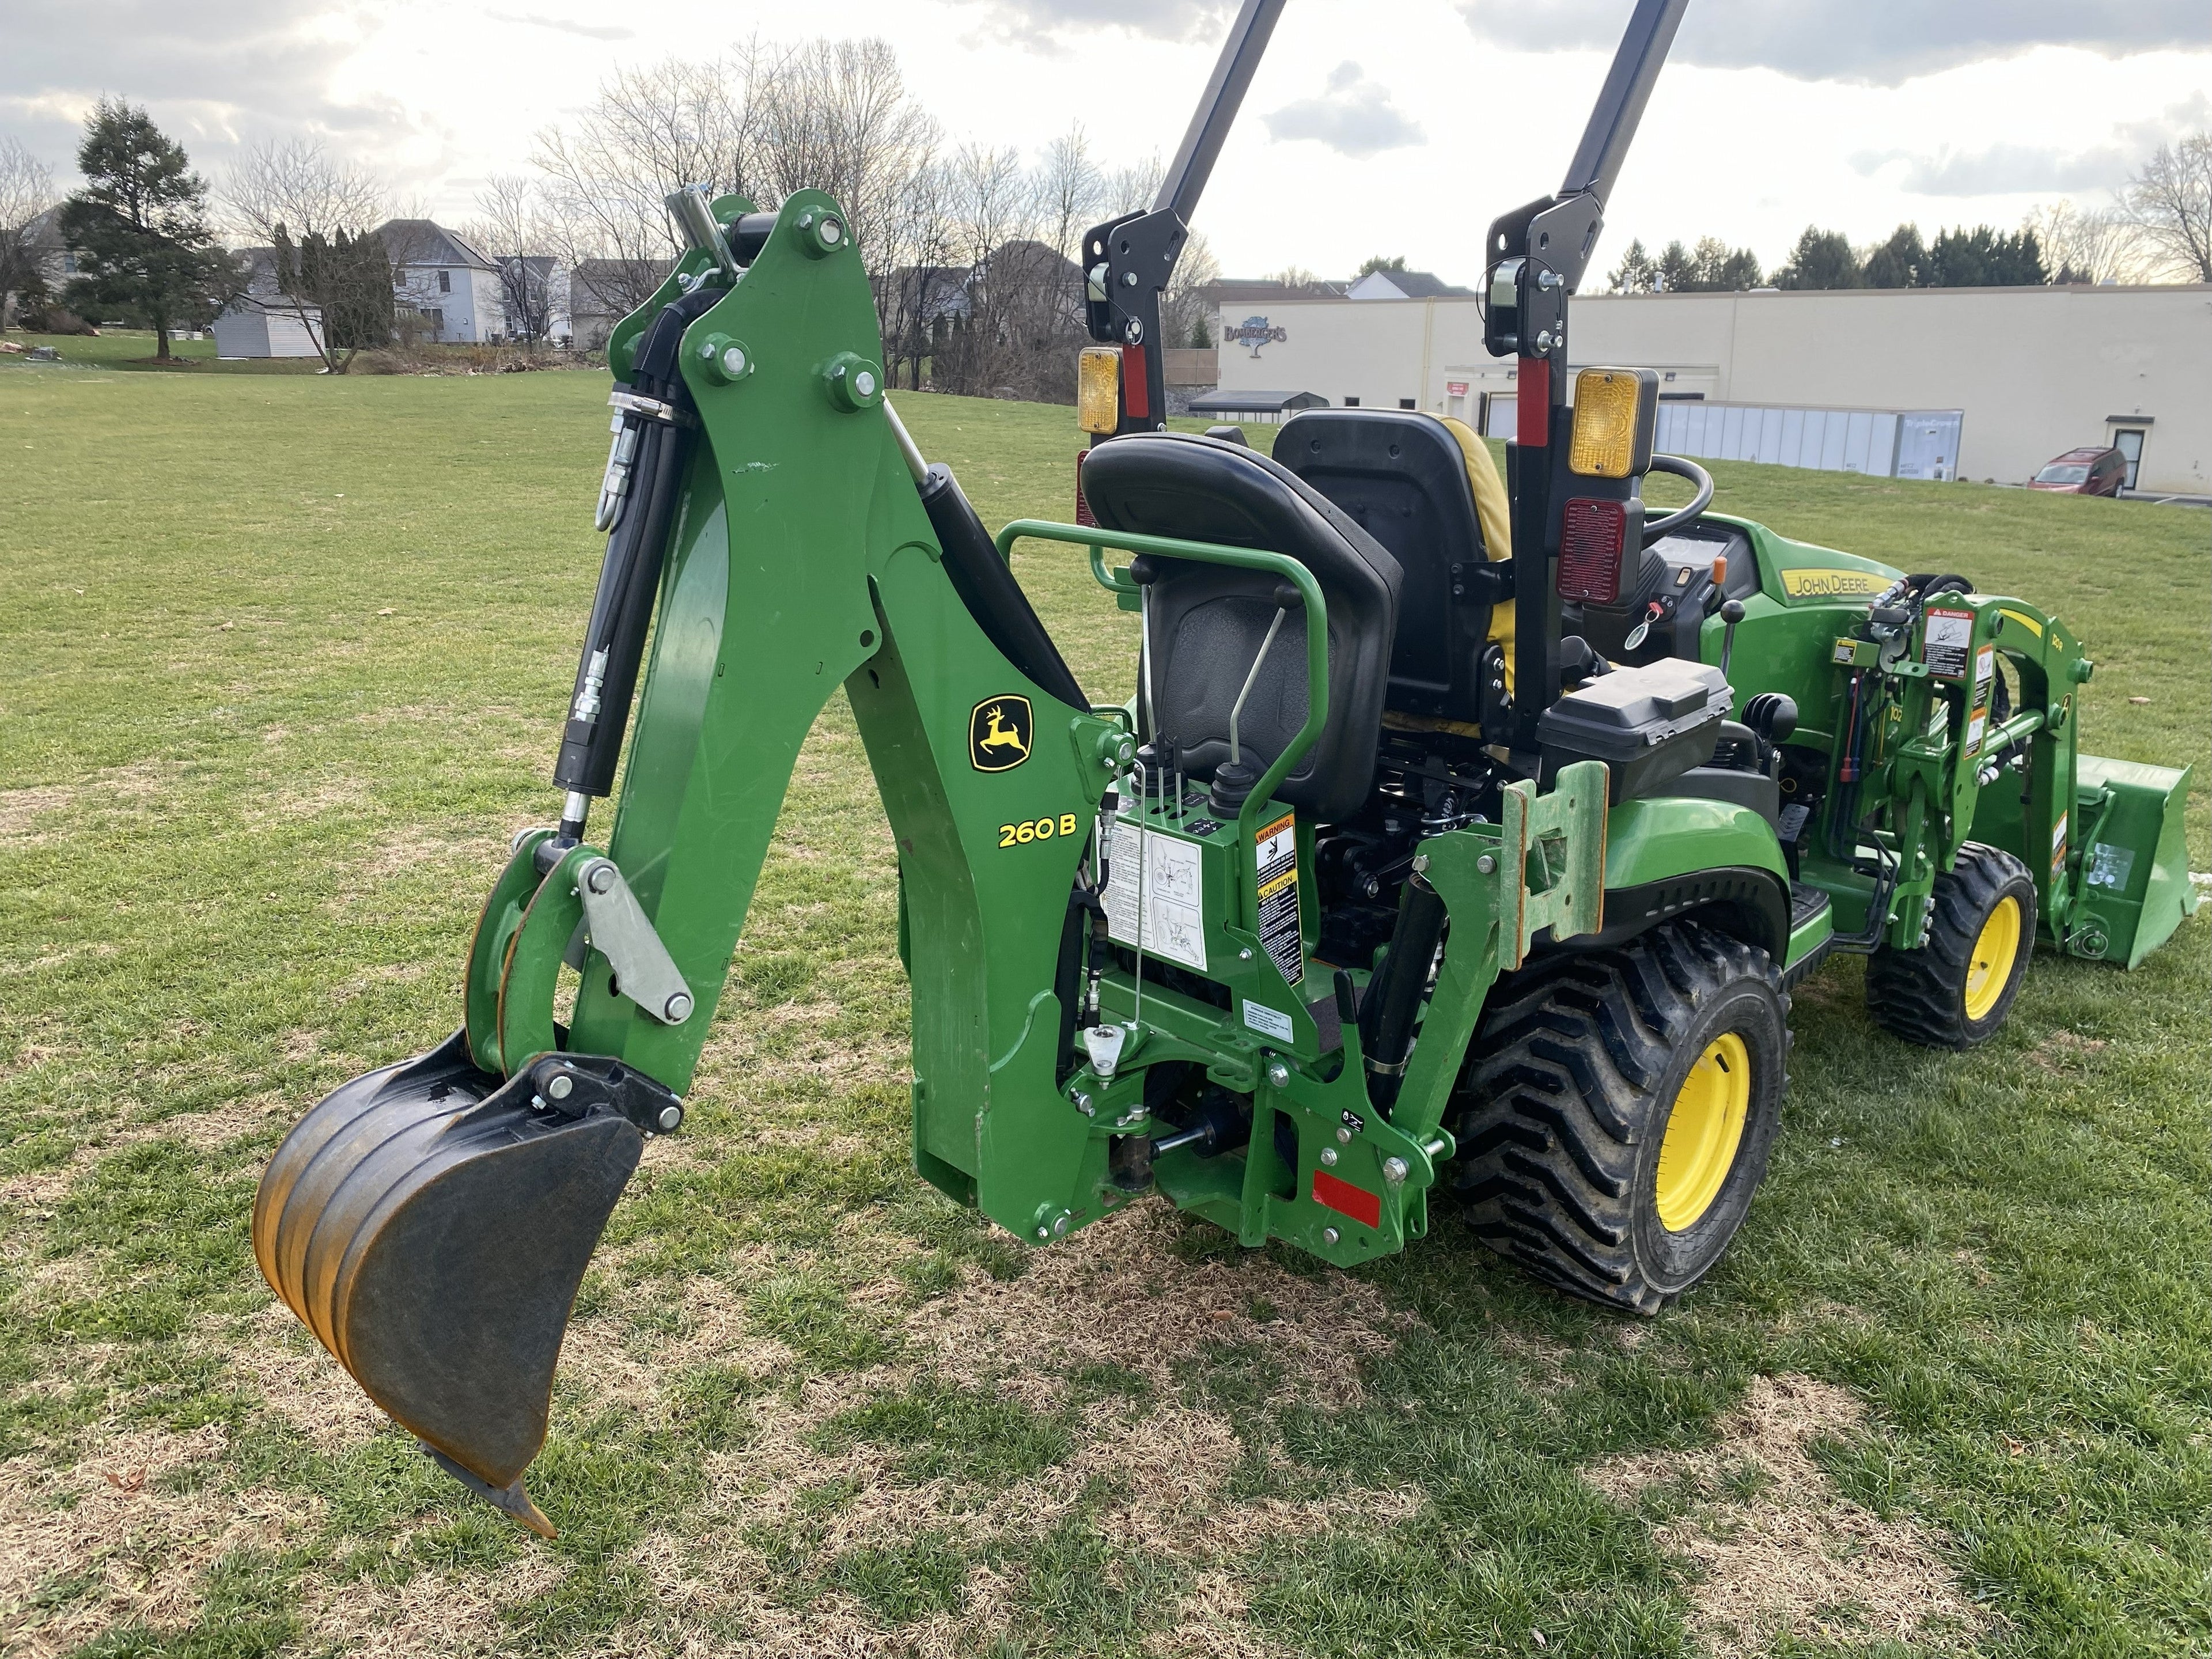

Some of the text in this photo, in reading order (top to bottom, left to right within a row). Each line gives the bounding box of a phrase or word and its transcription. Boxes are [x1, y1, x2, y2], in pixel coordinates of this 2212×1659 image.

[1796, 575, 1869, 593] JOHN DEERE
[999, 813, 1077, 848] 260 B
[1258, 819, 1290, 842] WARNING
[1263, 876, 1293, 897] CAUTION
